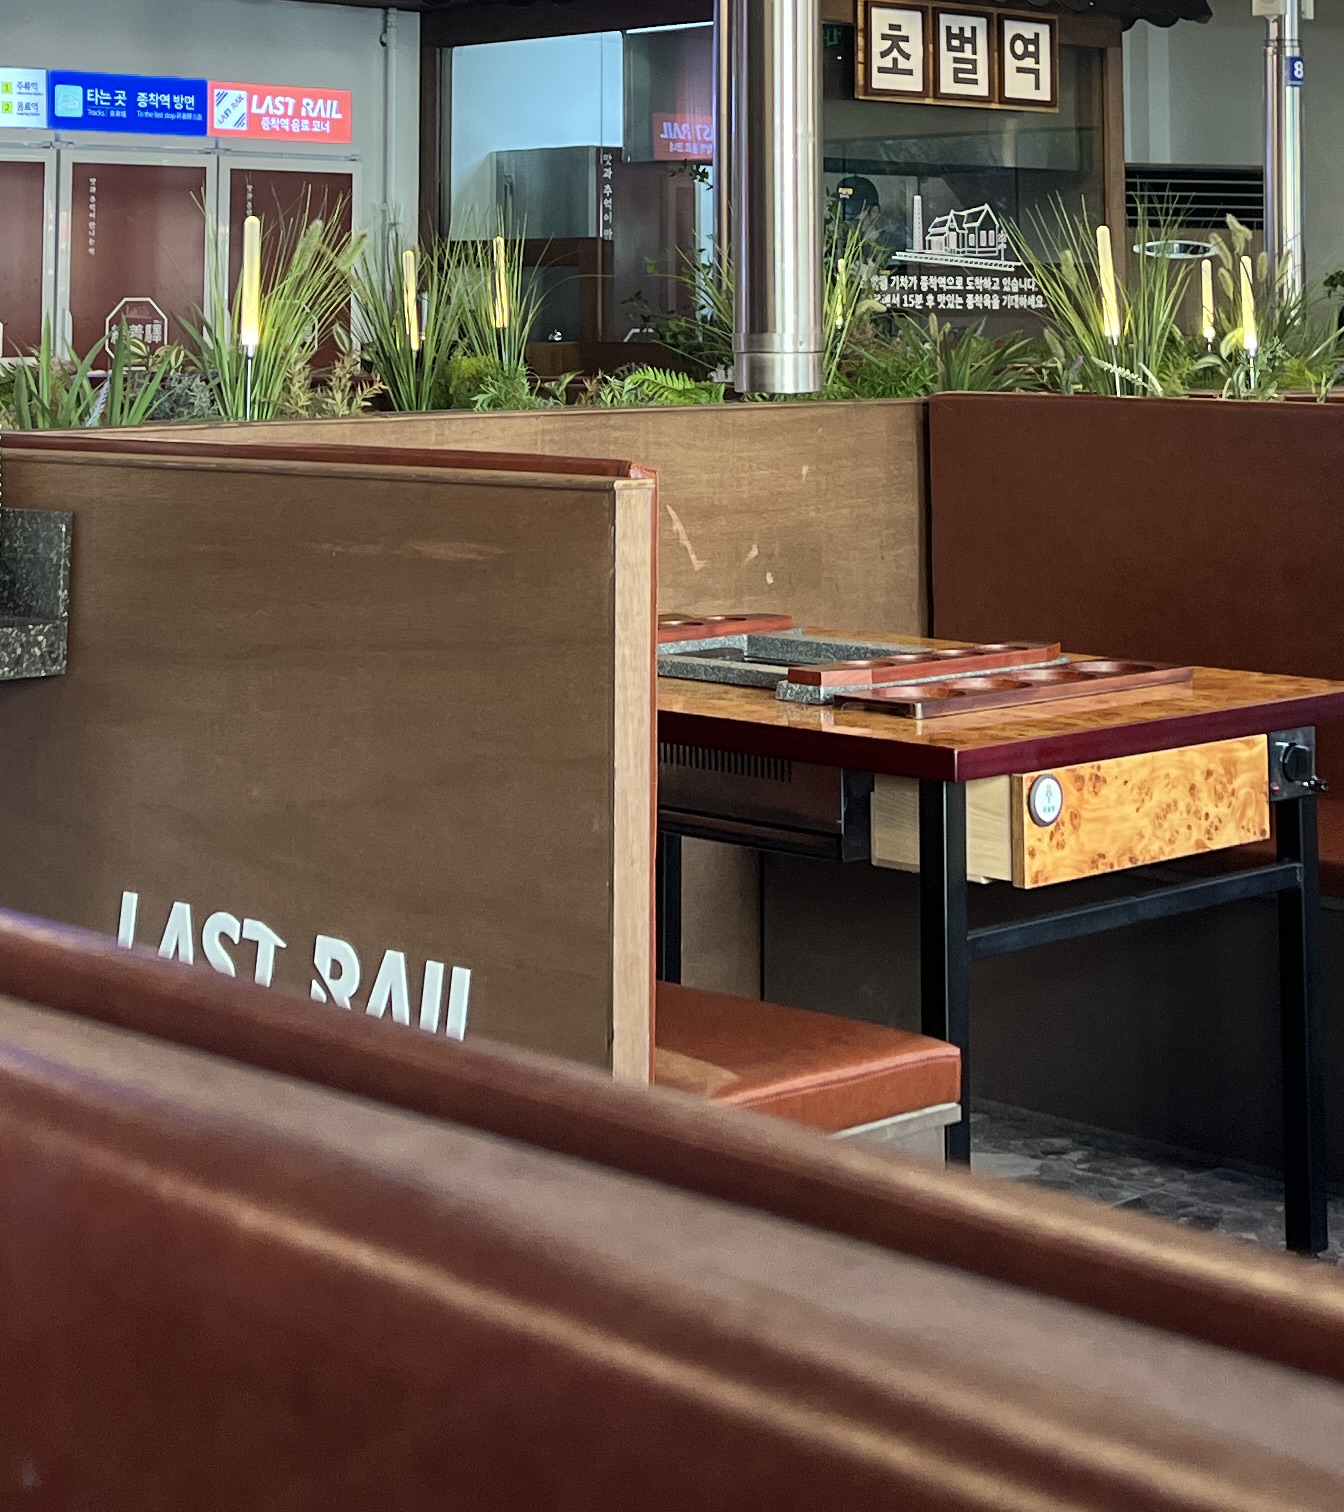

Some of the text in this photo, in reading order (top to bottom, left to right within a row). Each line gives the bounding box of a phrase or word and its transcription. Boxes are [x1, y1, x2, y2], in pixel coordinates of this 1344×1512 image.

[876, 23, 1041, 91] 초벌역
[1293, 60, 1304, 79] 8
[86, 88, 195, 111] 타는 곳 종착역 방면
[251, 94, 343, 119] LAST RAIL
[602, 183, 613, 224] 추억이
[890, 275, 918, 291] 기차가
[920, 275, 964, 292] 종착역으로
[965, 276, 1000, 292] 도착하고
[902, 293, 924, 309] 15분
[925, 293, 936, 309] 후
[936, 293, 964, 309] 맛있는
